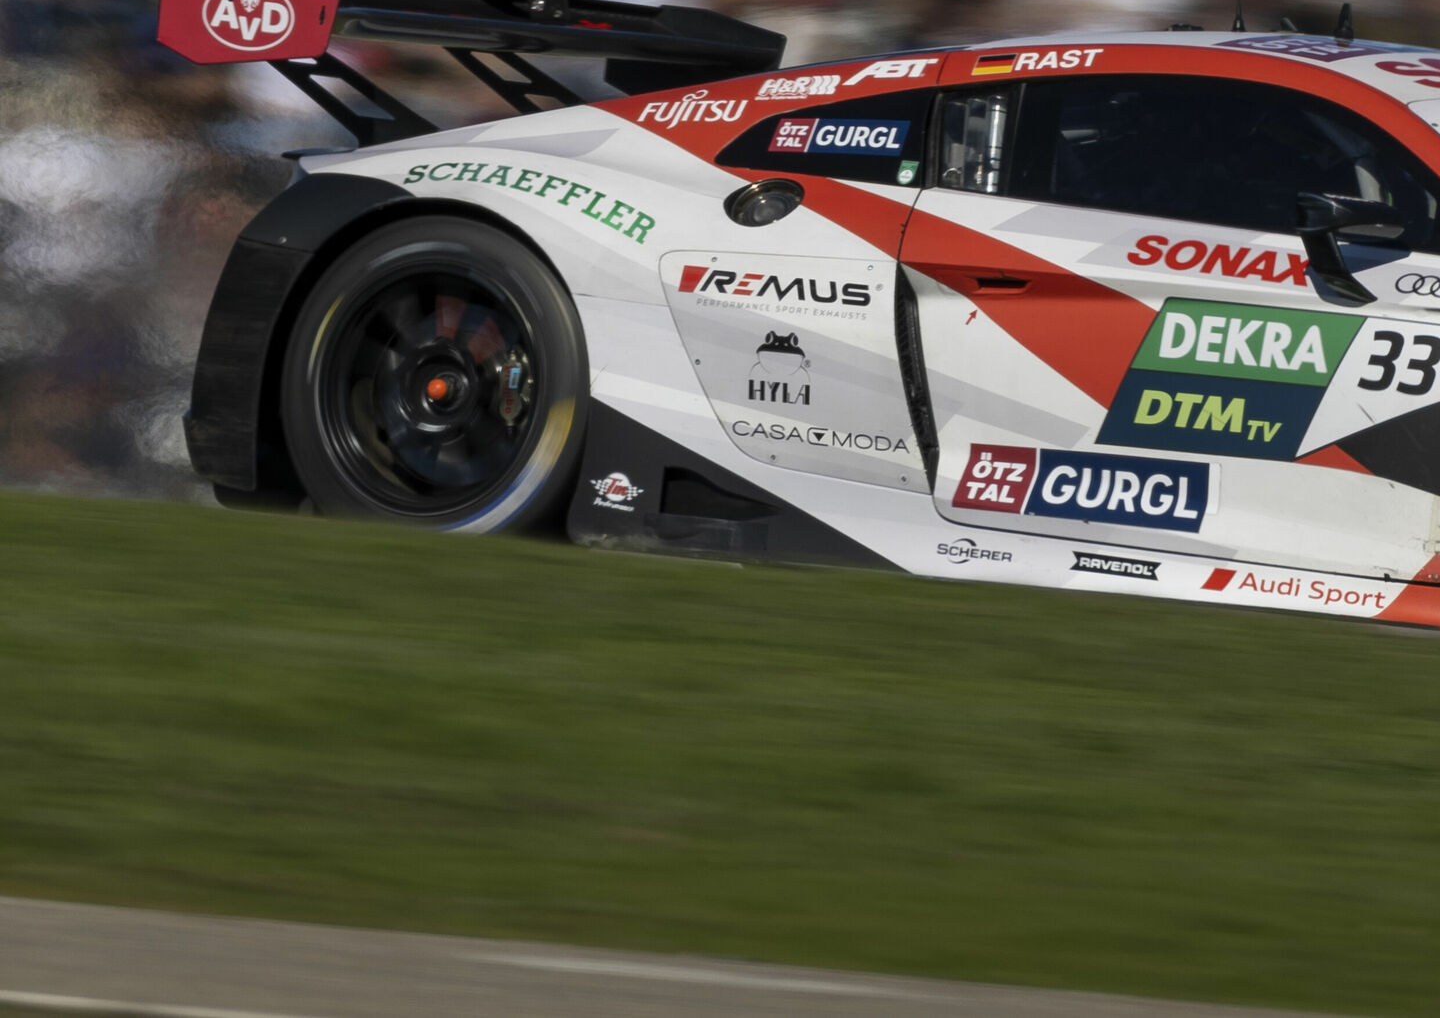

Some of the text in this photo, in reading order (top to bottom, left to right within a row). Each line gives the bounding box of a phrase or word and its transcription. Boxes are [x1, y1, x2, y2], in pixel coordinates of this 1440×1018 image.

[842, 58, 939, 86] ABT
[1014, 49, 1105, 71] RAST
[757, 77, 812, 97] H&R
[637, 90, 748, 129] FUJITSU
[776, 136, 803, 147] TAL
[779, 121, 809, 136] ÖTZ
[815, 125, 901, 149] GURGL
[404, 162, 656, 244] SCHAEFFLER
[1127, 235, 1311, 287] SONAX
[700, 270, 872, 307] REMUS
[696, 298, 868, 321] PERFORMANCE SPORT EXHAUSTS
[1158, 312, 1328, 374] DEKRA
[748, 379, 811, 405] HYLA
[1133, 389, 1282, 443] DTM TV
[732, 420, 910, 454] CASA MODA
[971, 452, 1028, 483] ÖTZ
[966, 481, 1016, 505] TAL
[1041, 464, 1200, 520] GURGL
[936, 542, 1013, 563] SCHERER
[1079, 556, 1153, 577] RAVENOL
[1238, 571, 1386, 610] Audi Sport
